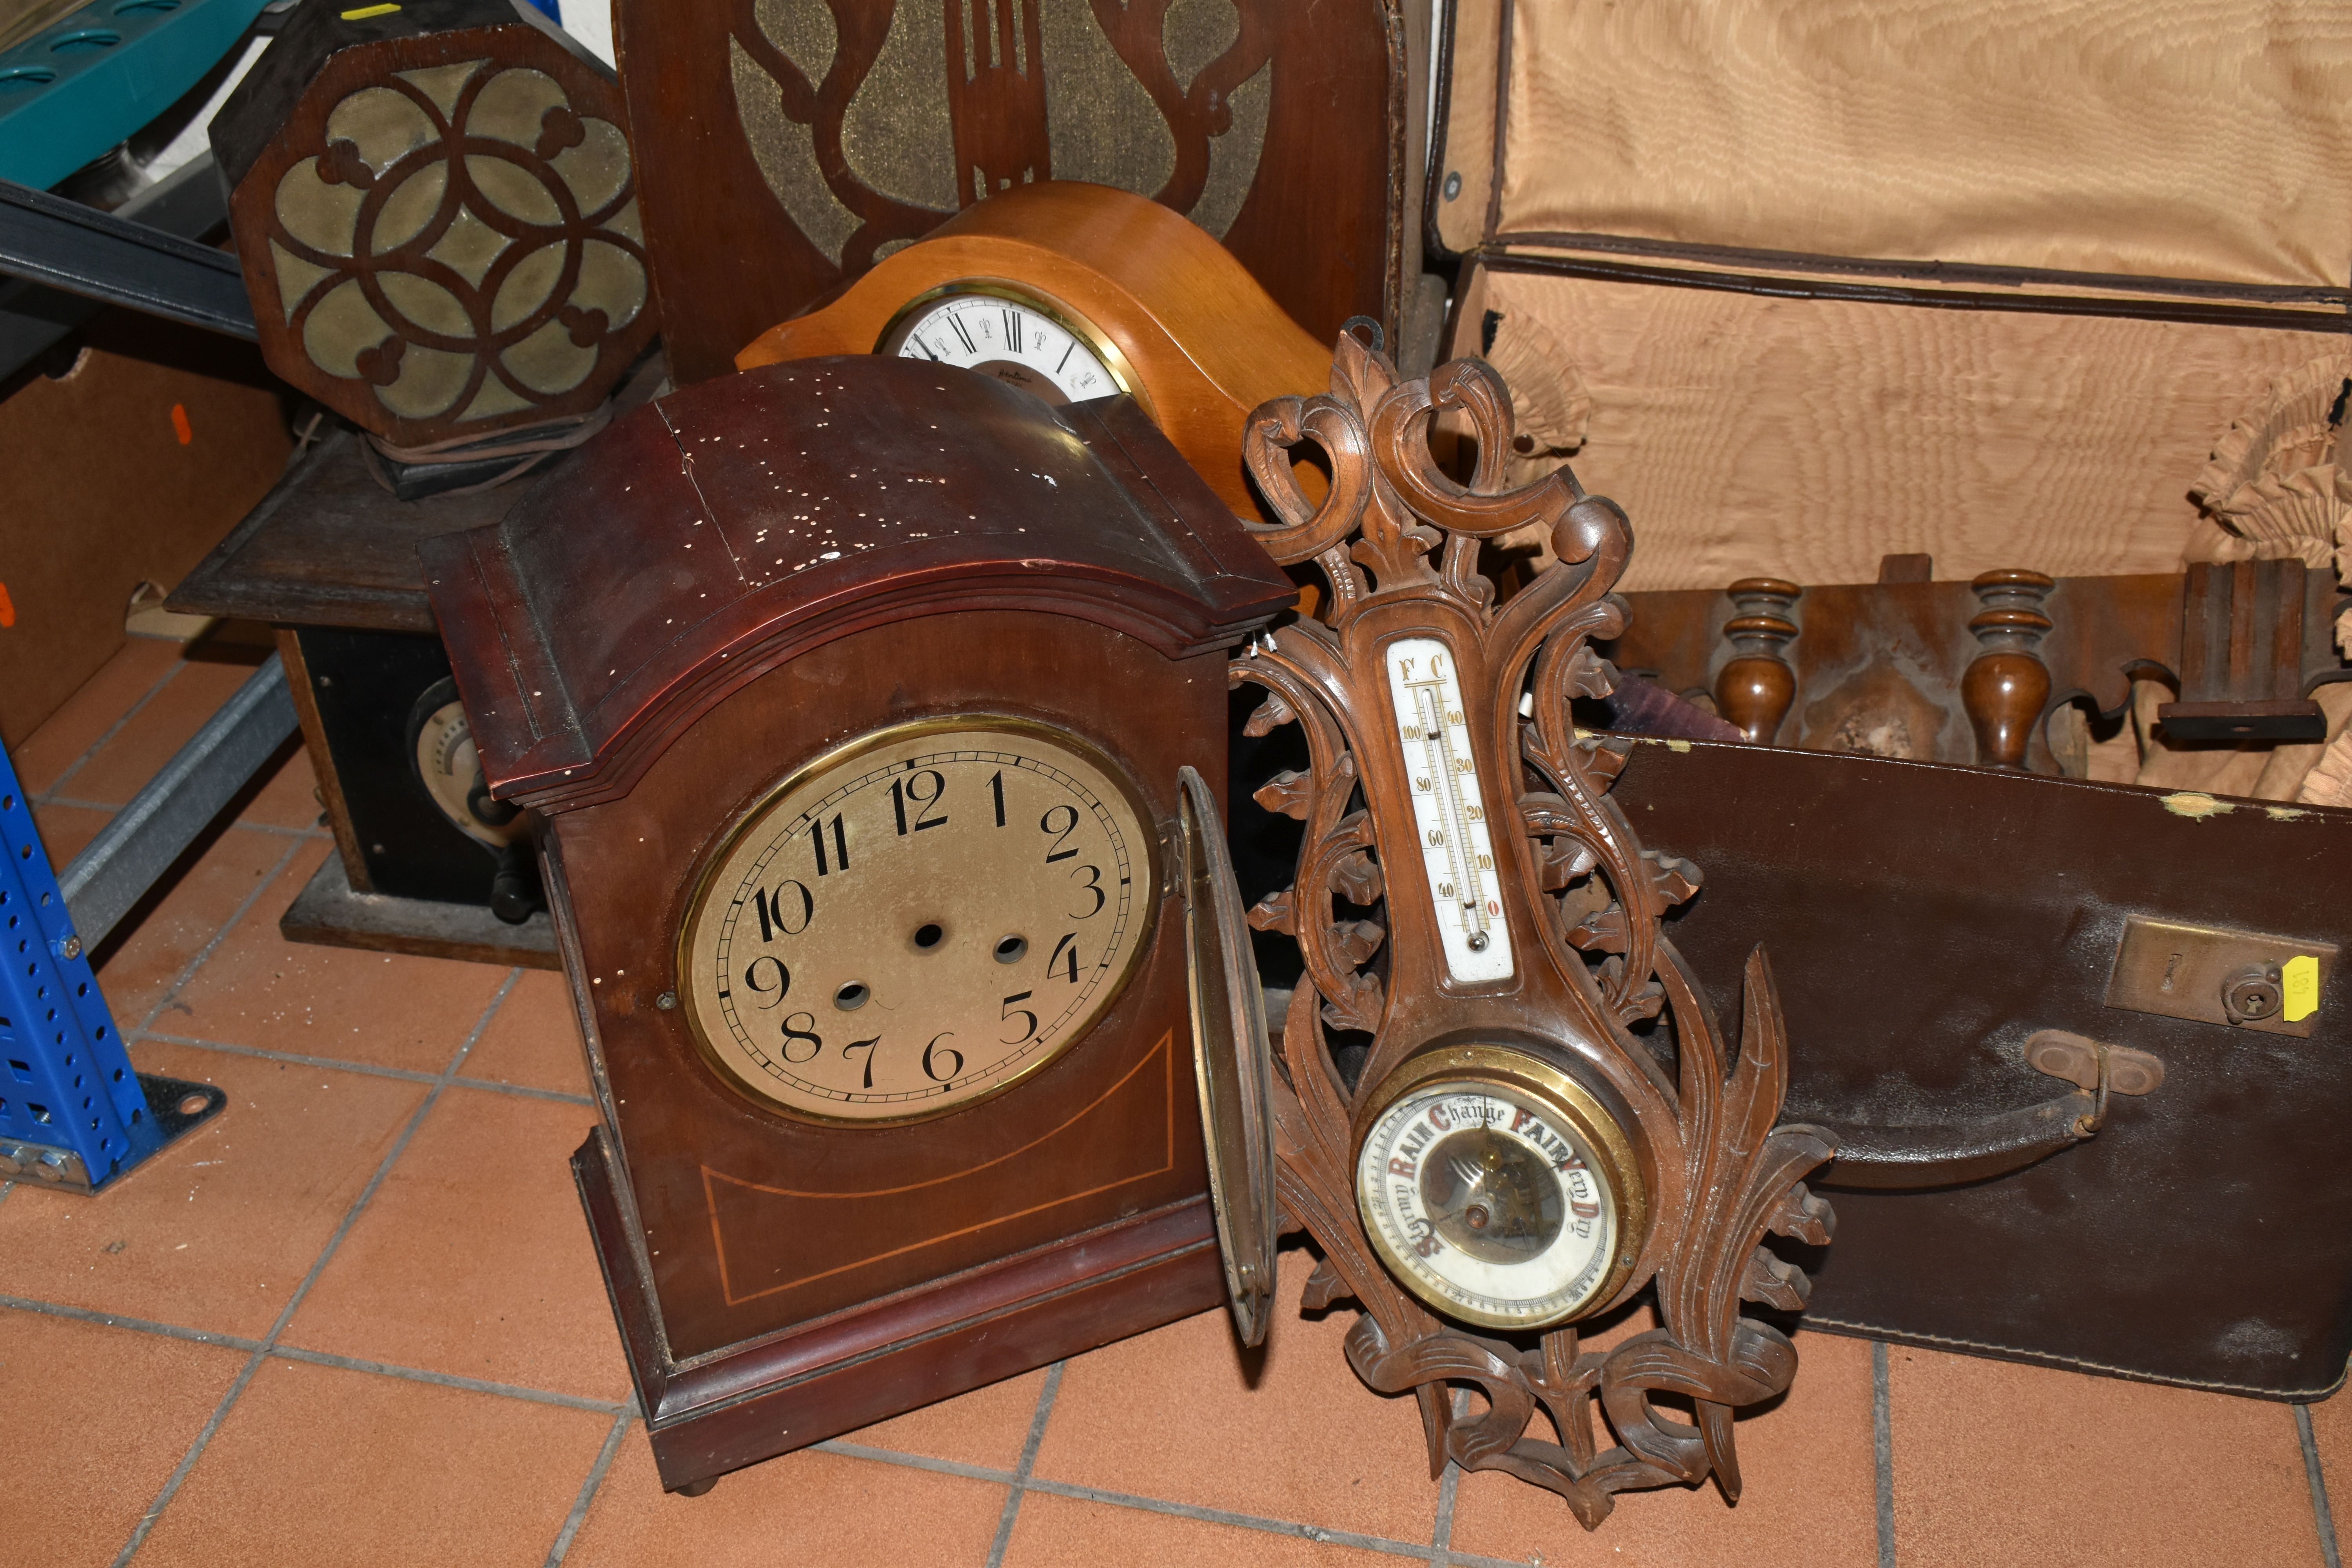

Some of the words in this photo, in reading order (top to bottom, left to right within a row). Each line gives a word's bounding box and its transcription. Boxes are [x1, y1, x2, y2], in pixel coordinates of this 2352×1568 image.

[1002, 309, 1022, 354] XII
[1403, 725, 1421, 740] 100
[1447, 711, 1463, 724] 40
[1416, 777, 1431, 791] 80
[1456, 759, 1472, 772] 30
[885, 770, 948, 837] 12
[985, 769, 1005, 828] 1
[1466, 806, 1483, 820] 20
[804, 812, 849, 877] 11
[1040, 805, 1079, 864] 2
[1428, 829, 1444, 846] 60
[1476, 855, 1492, 869] 10
[751, 880, 814, 943] 10
[1068, 865, 1105, 919] 3
[1438, 882, 1454, 898] 40
[745, 956, 790, 1009] 9
[1047, 932, 1088, 984] 4
[780, 1012, 822, 1063] 8
[999, 991, 1038, 1044] 5
[843, 1034, 882, 1089] 7
[922, 1032, 964, 1081] 6
[1429, 1102, 1505, 1131] Change
[1510, 1108, 1568, 1166] FAIR
[1388, 1121, 1435, 1182] RAIN
[1559, 1151, 1589, 1198] Very
[1395, 1185, 1446, 1258] Stormy
[1566, 1201, 1599, 1238] Dry
